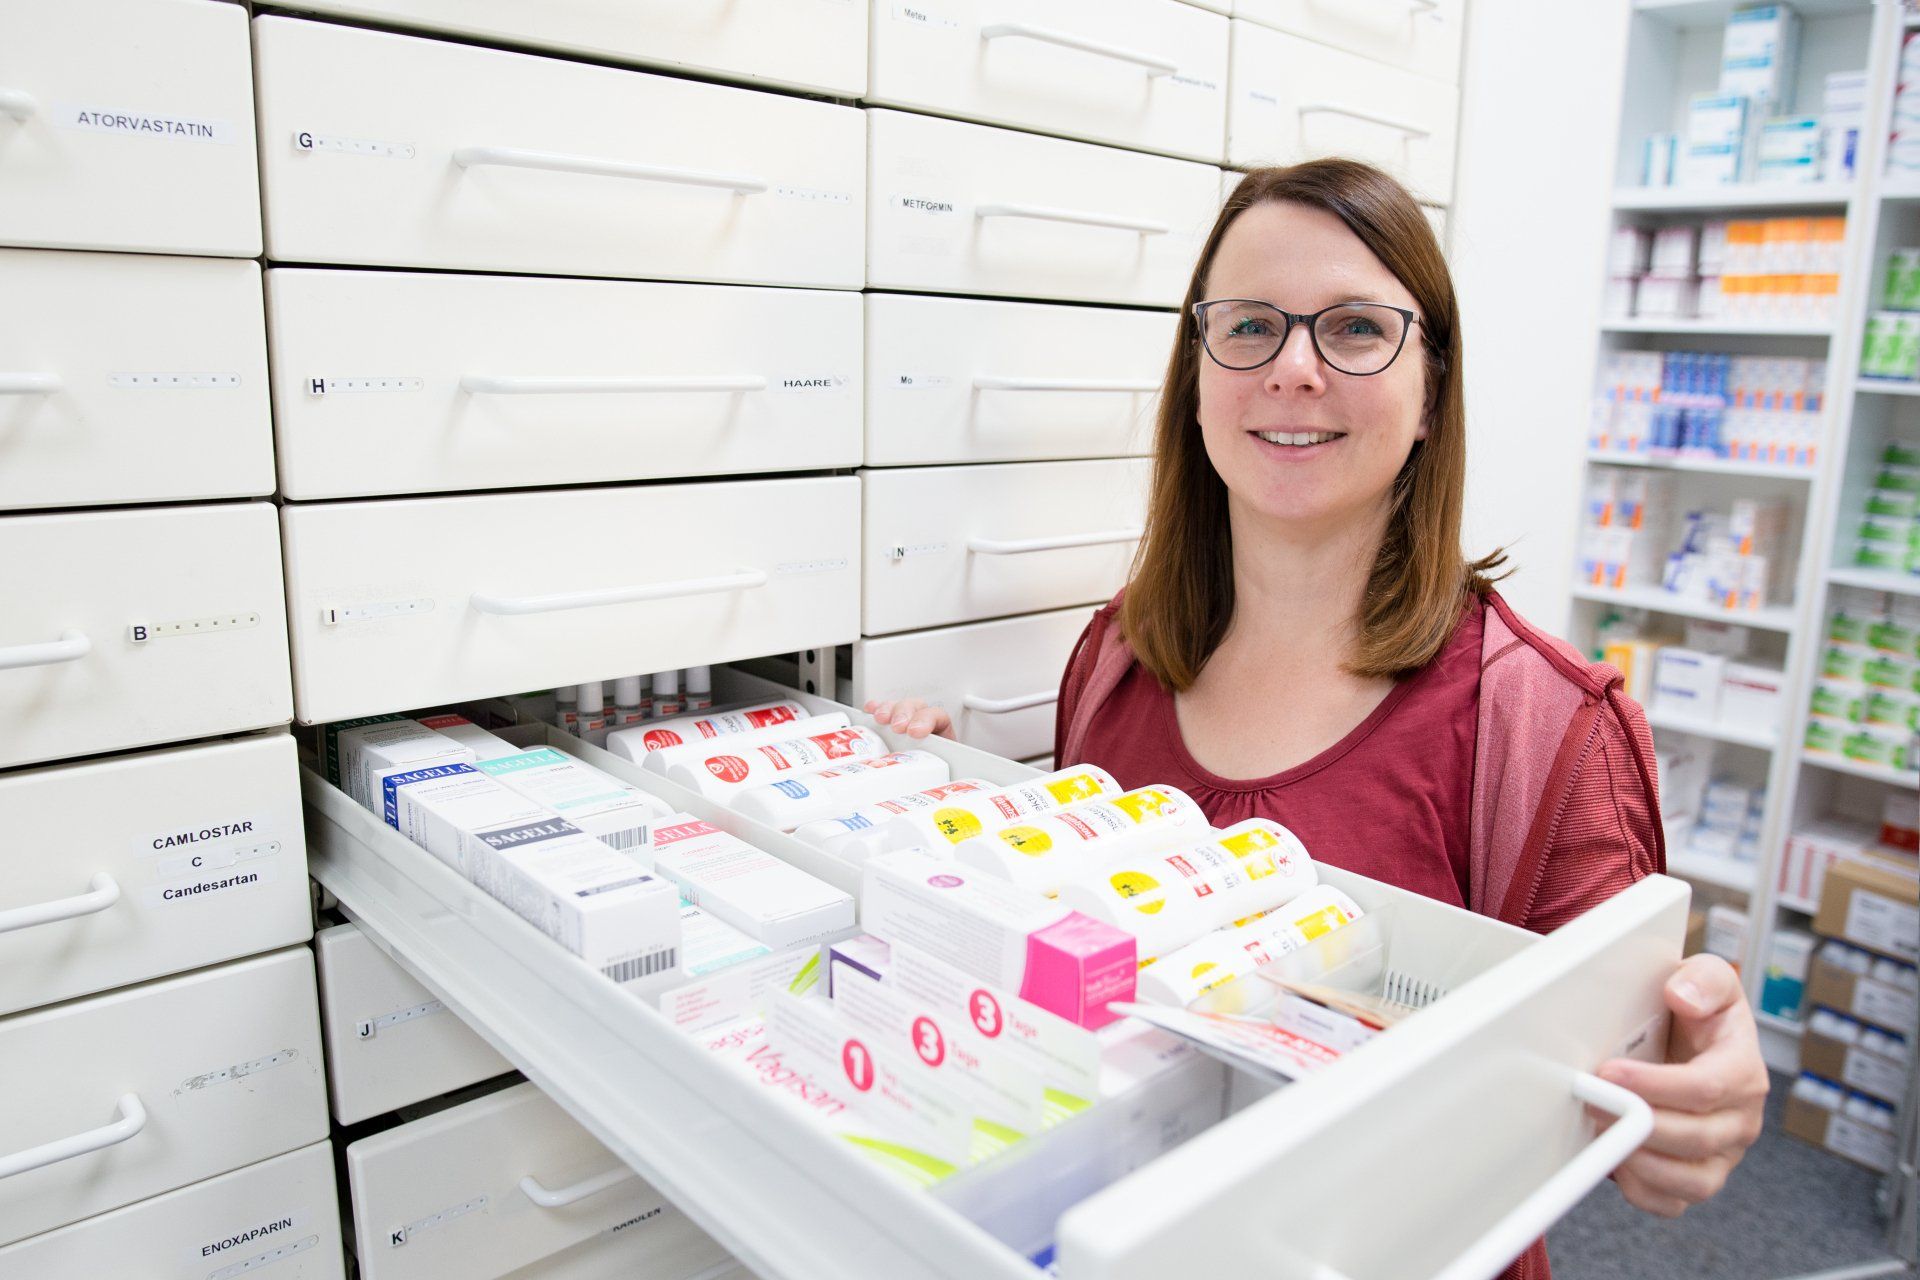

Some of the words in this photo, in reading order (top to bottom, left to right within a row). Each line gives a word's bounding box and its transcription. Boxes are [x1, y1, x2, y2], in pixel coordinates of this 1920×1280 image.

[903, 7, 927, 21] Metex
[78, 111, 213, 138] ATORVASTATIN
[299, 132, 313, 148] G
[903, 198, 953, 212] METFORMIN
[312, 378, 325, 394] H
[784, 379, 832, 388] HAARE
[900, 376, 913, 385] Mo
[897, 547, 904, 557] N
[133, 626, 148, 641] B
[485, 752, 564, 774] SAGELLA
[390, 763, 473, 785] SAGELLA
[152, 821, 253, 850] CAMLOSTAR
[484, 822, 577, 847] SAGELLA
[191, 856, 203, 868] C
[162, 873, 258, 900] Candesartan
[361, 1023, 370, 1037] J
[746, 1043, 848, 1118] Vagisan
[202, 1217, 292, 1257] ENOXAPARIN
[392, 1230, 404, 1245] K
